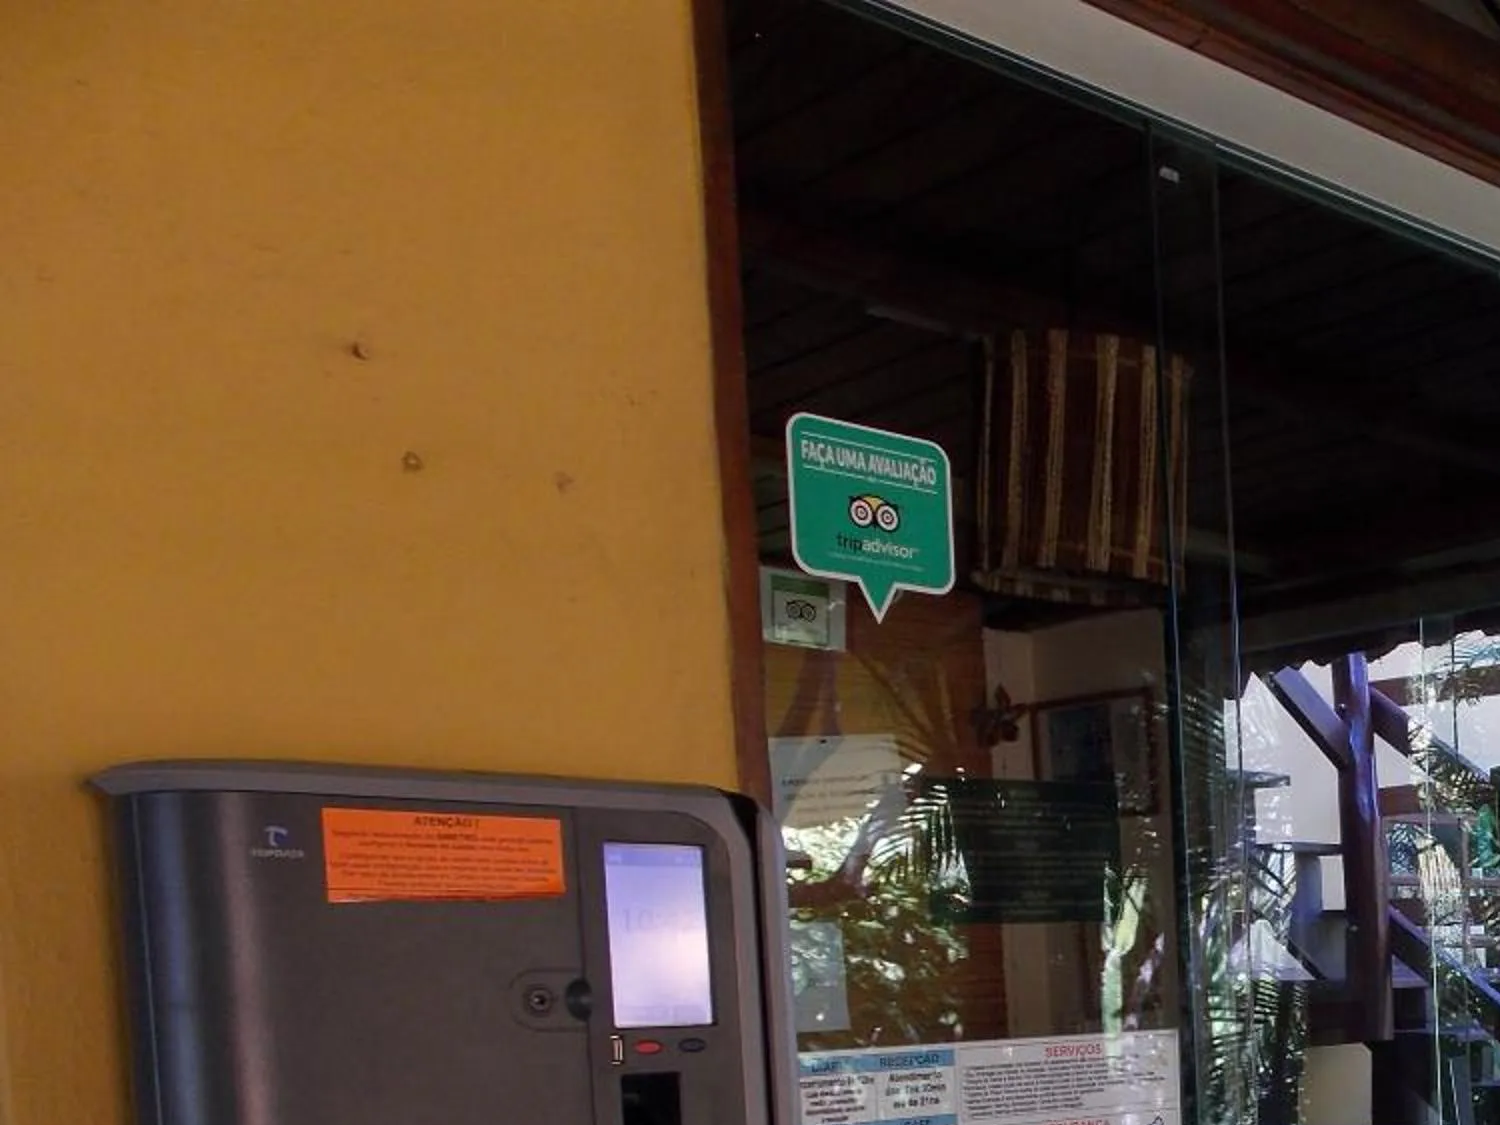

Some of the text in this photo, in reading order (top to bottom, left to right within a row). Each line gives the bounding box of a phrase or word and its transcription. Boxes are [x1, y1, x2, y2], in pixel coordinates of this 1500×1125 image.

[801, 439, 937, 487] FAÇA UMA AVALIAÇÃO
[837, 534, 915, 559] tripadvisor
